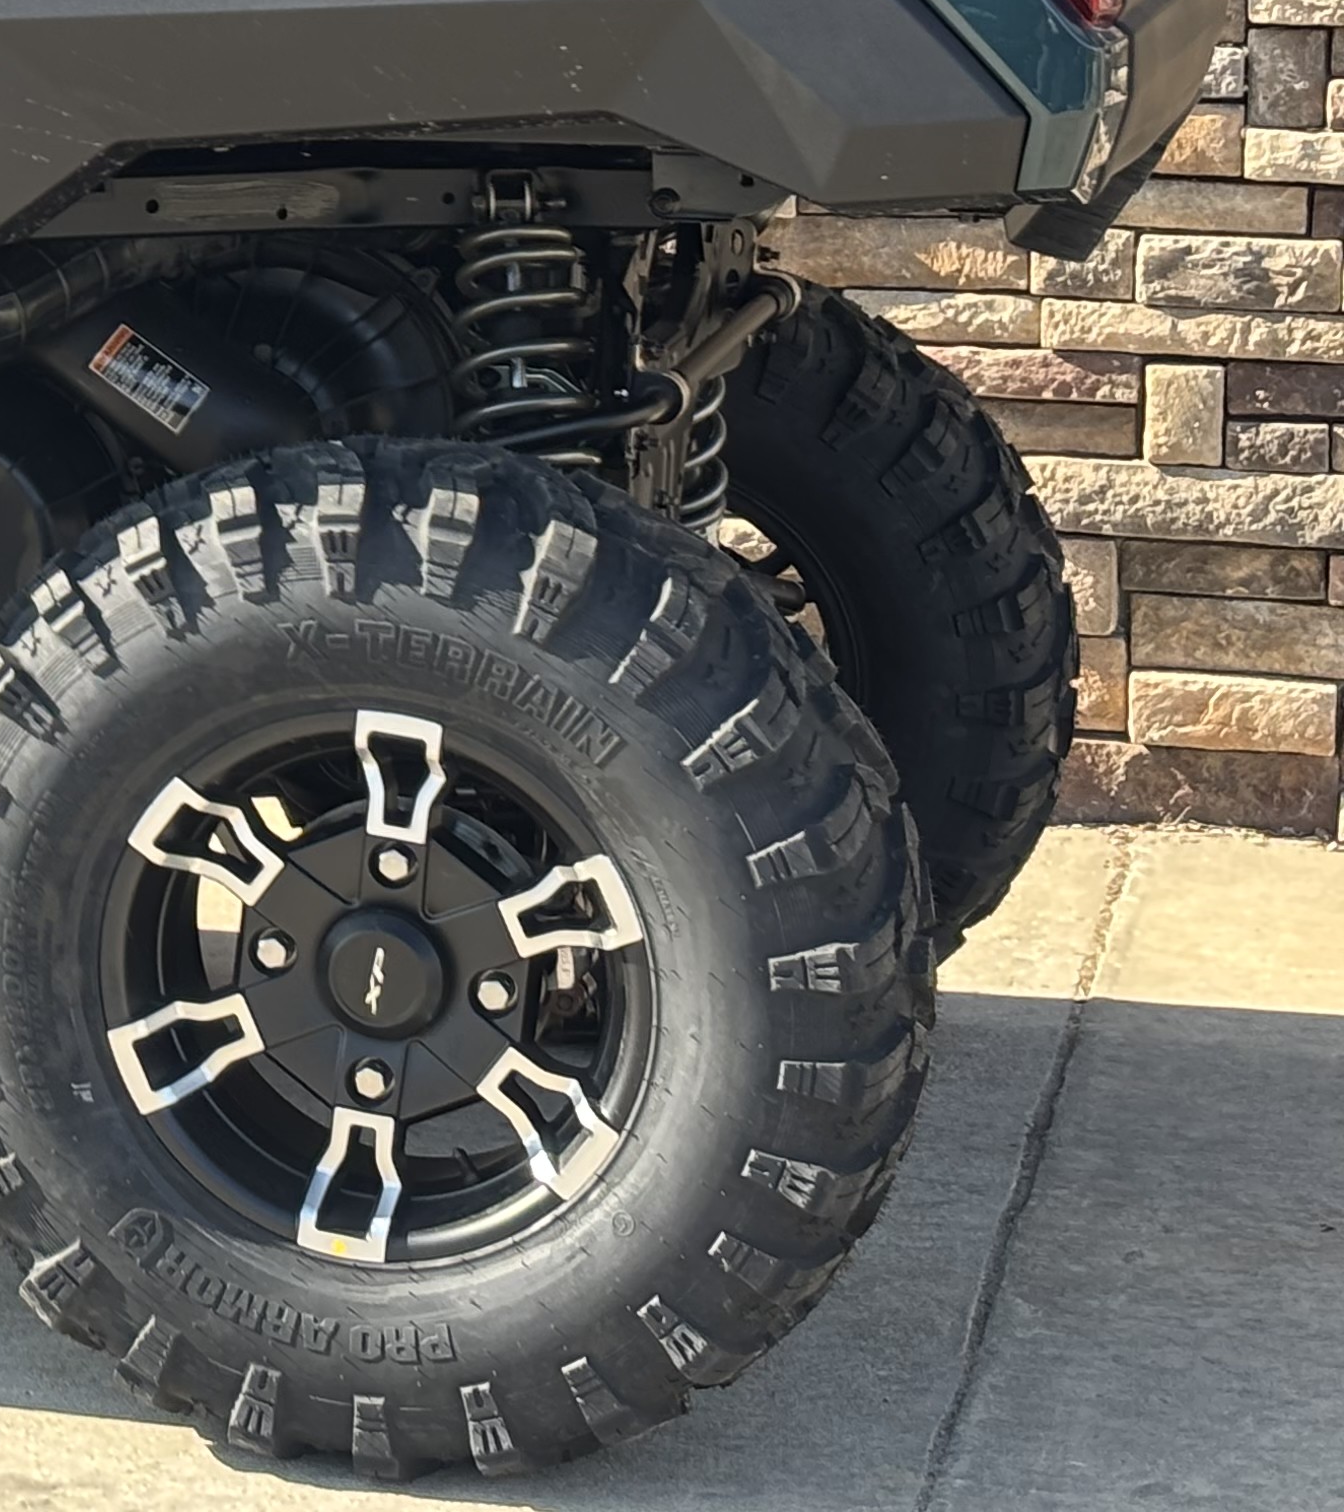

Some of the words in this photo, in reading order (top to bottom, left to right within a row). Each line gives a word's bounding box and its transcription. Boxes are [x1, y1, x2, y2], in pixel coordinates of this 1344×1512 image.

[276, 618, 628, 771] X-TERRAIN
[365, 947, 385, 1016] XP
[156, 1242, 341, 1354] ARMOR
[348, 1321, 458, 1364] PRO
